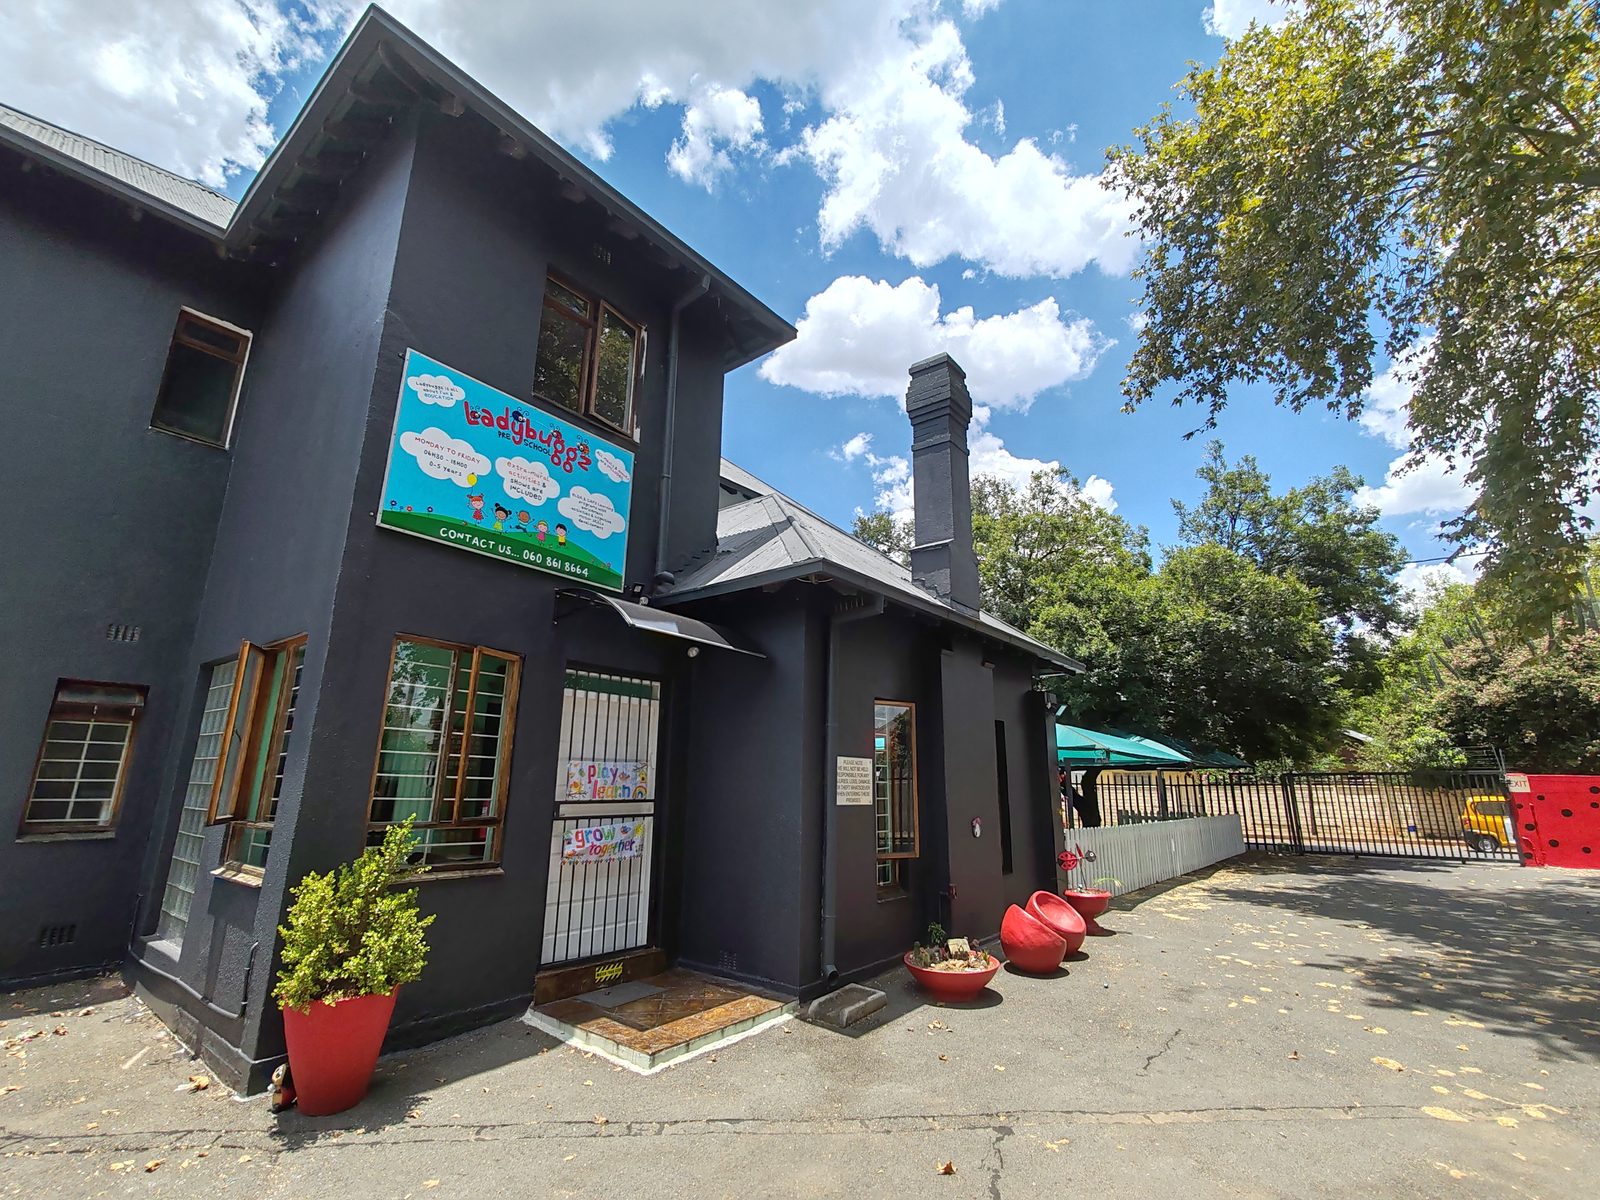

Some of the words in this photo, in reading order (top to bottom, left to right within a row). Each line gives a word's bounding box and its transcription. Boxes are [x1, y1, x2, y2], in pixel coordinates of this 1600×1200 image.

[415, 437, 444, 451] MONDAY
[447, 447, 456, 455] TO
[458, 452, 481, 464] FRIDAY
[498, 431, 511, 441] PRE
[524, 439, 551, 456] SCHOOL
[424, 449, 444, 461] 06H30
[451, 459, 468, 469] 18H00
[509, 470, 541, 486] activities
[439, 527, 496, 549] CONTACT
[522, 549, 543, 564] 060
[546, 556, 562, 569] 861
[564, 560, 589, 578] 8664
[587, 763, 619, 785] play
[1509, 780, 1527, 788] EXIT
[592, 780, 631, 799] learn
[575, 825, 616, 849] grow
[588, 838, 636, 859] together
